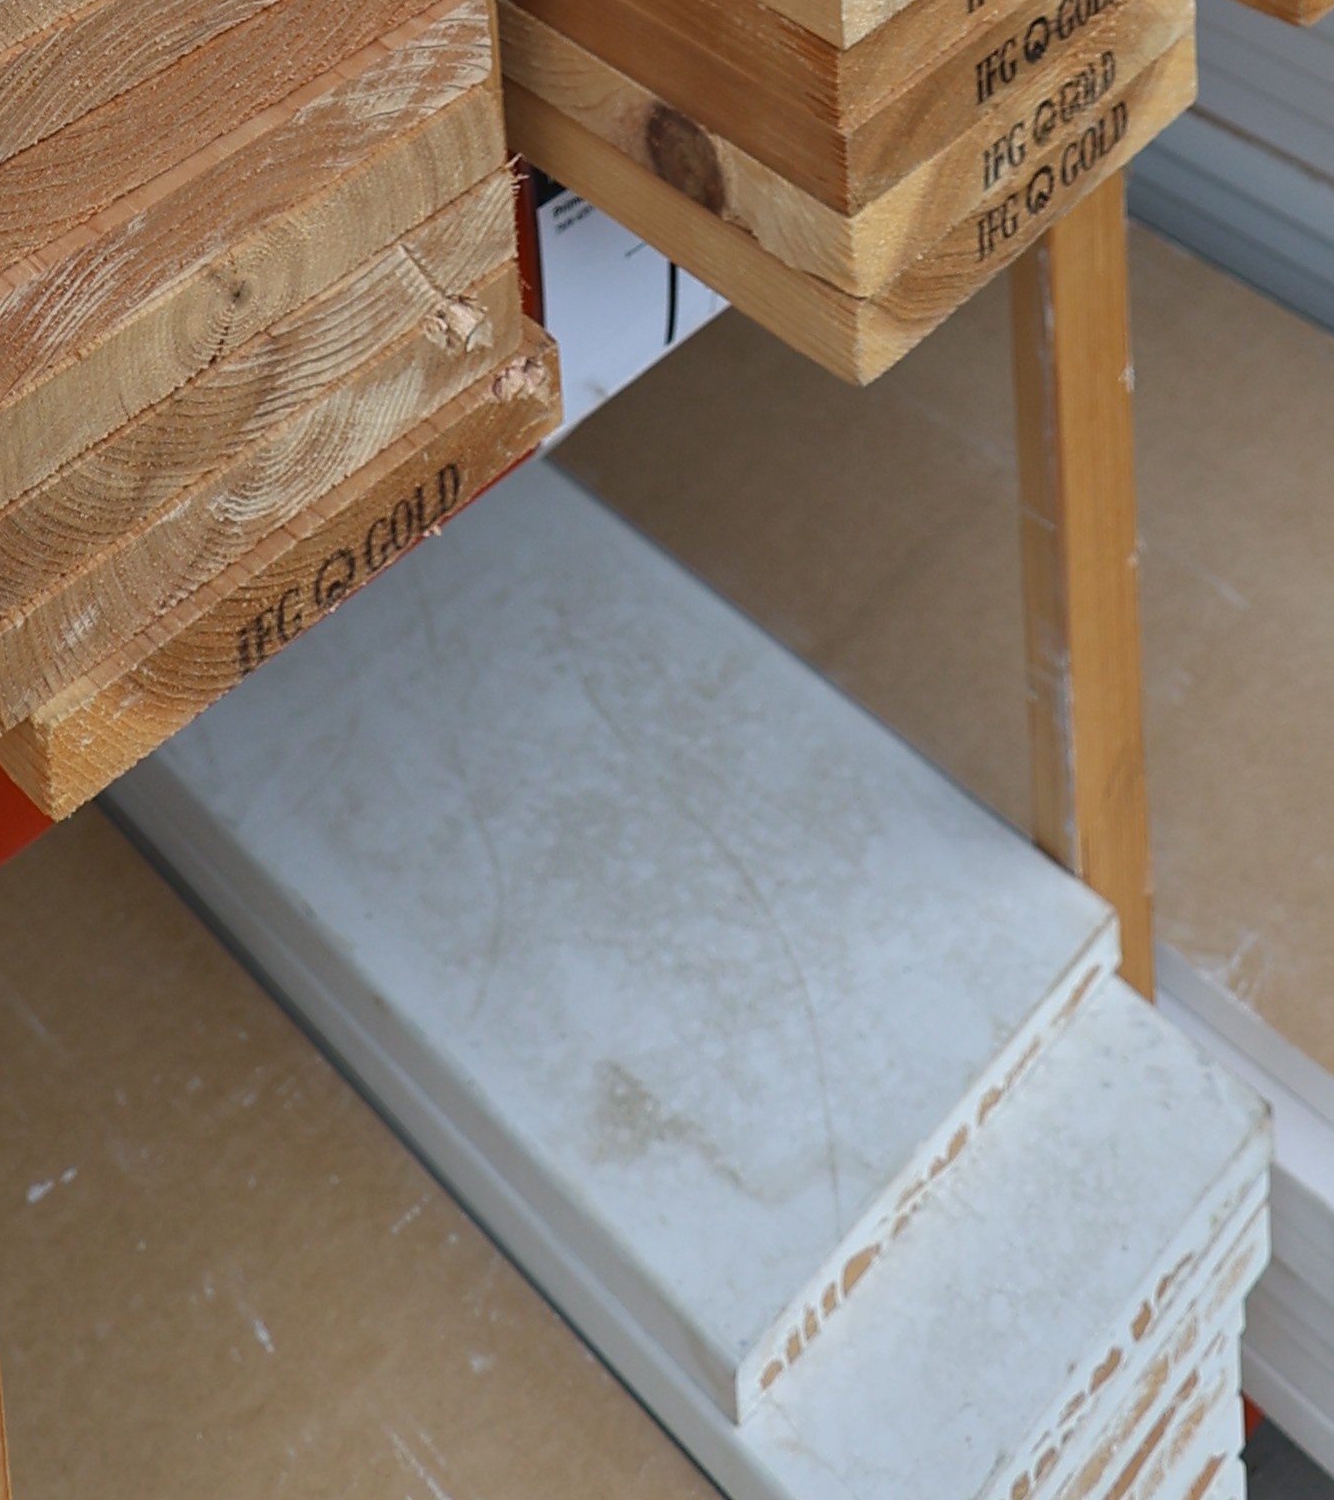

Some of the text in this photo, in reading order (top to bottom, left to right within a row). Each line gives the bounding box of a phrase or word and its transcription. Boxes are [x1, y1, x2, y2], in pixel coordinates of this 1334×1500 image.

[975, 36, 1018, 106] IFG
[976, 99, 1131, 263] IFG GOLD
[365, 463, 462, 573] GOLD
